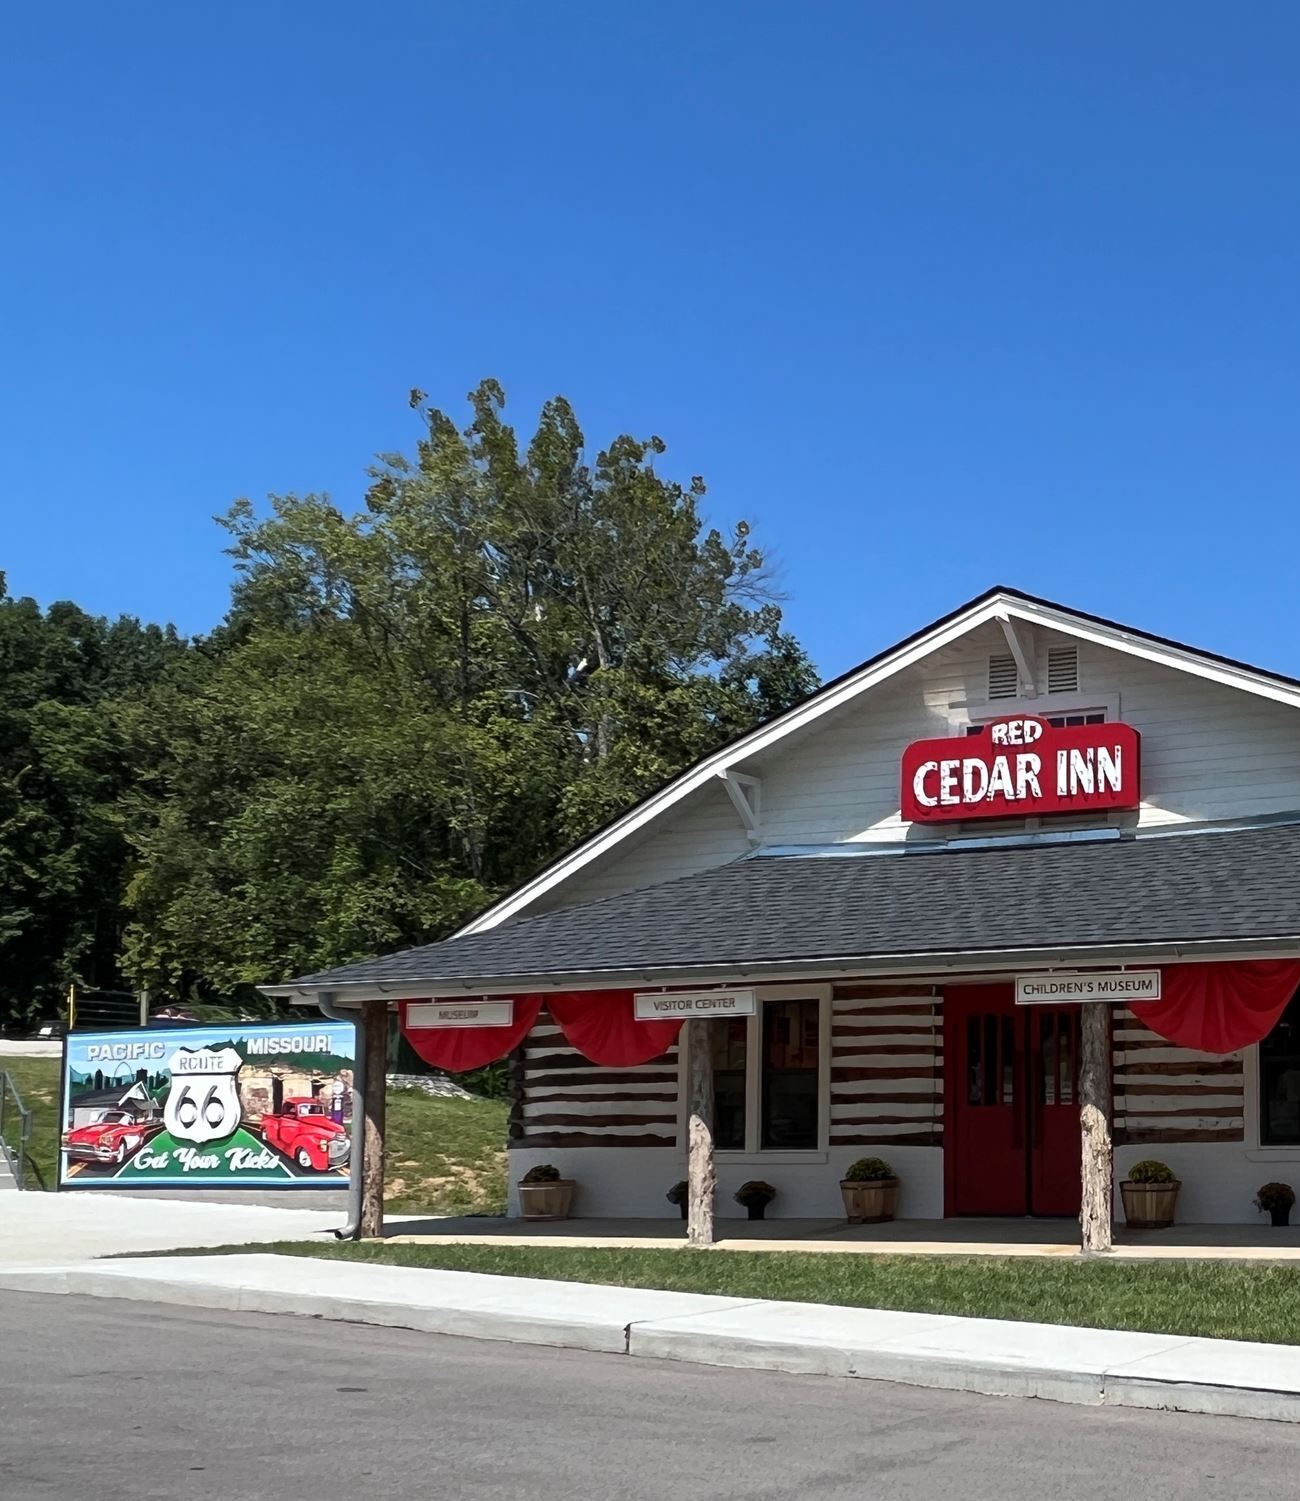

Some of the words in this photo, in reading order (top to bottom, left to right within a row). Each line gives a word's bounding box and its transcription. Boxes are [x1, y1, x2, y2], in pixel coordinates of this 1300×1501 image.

[992, 720, 1043, 746] RED
[913, 753, 1043, 807] CEDAR
[1057, 745, 1122, 796] INN
[1023, 981, 1094, 995] CHILDREN'S
[1097, 979, 1153, 992] MUSEUM
[653, 1000, 692, 1011] VISITOR
[695, 998, 736, 1009] CENTER
[87, 1042, 165, 1061] PACIFIC
[246, 1035, 332, 1055] MISSOURI
[179, 1055, 224, 1071] ROUTE
[175, 1085, 225, 1129] 66
[134, 1149, 169, 1170] Get
[172, 1148, 220, 1171] Your
[224, 1148, 280, 1171] Kicks
